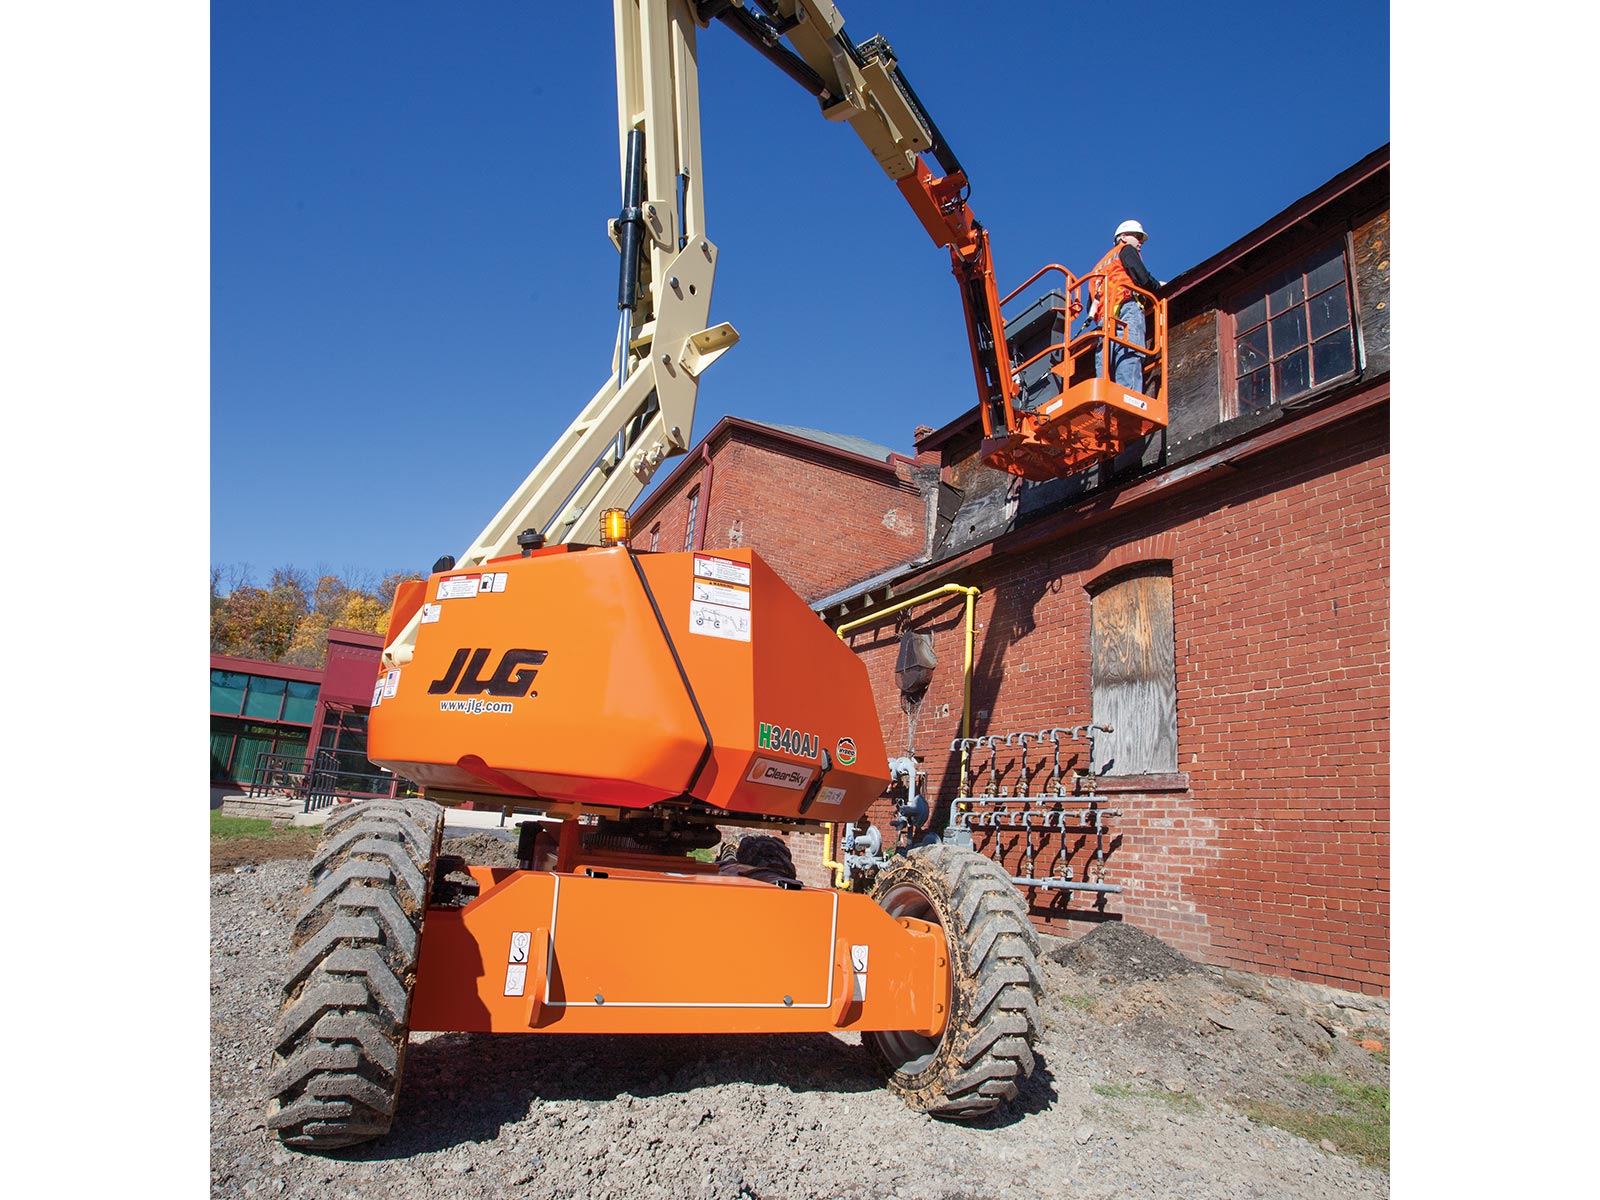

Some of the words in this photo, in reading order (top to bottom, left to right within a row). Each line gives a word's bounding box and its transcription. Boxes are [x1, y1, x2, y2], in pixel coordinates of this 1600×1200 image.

[440, 699, 512, 714] www.jlg.com
[758, 722, 819, 759] H340AJ
[765, 767, 807, 786] ClearSky
